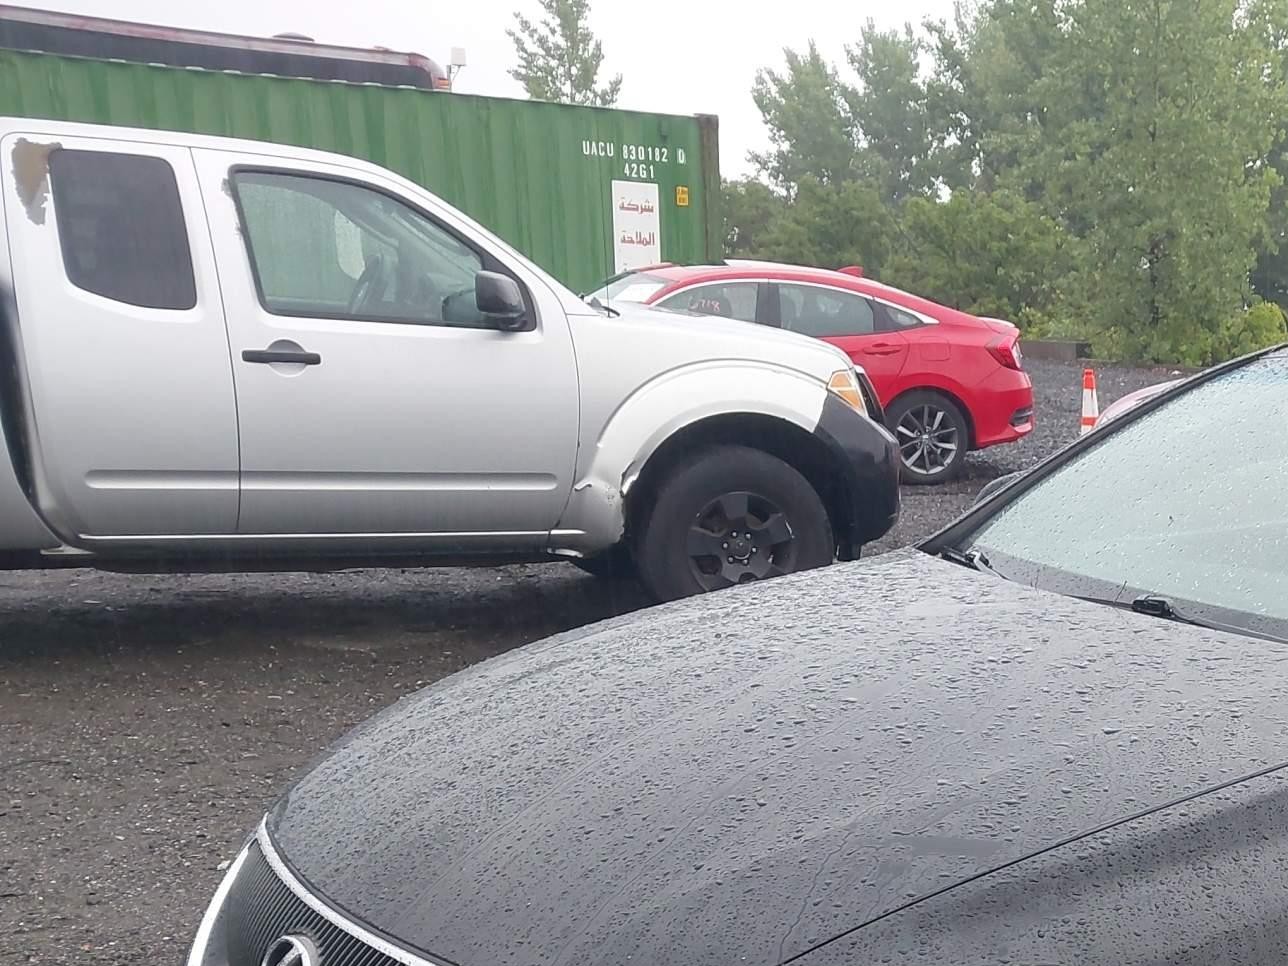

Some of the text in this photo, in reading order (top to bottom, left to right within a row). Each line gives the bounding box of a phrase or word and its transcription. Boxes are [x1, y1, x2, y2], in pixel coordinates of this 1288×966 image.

[582, 140, 614, 157] UACU
[622, 144, 668, 163] 830182
[624, 163, 655, 178] 42G1
[619, 196, 654, 214] شركة
[620, 230, 655, 246] الملاحة
